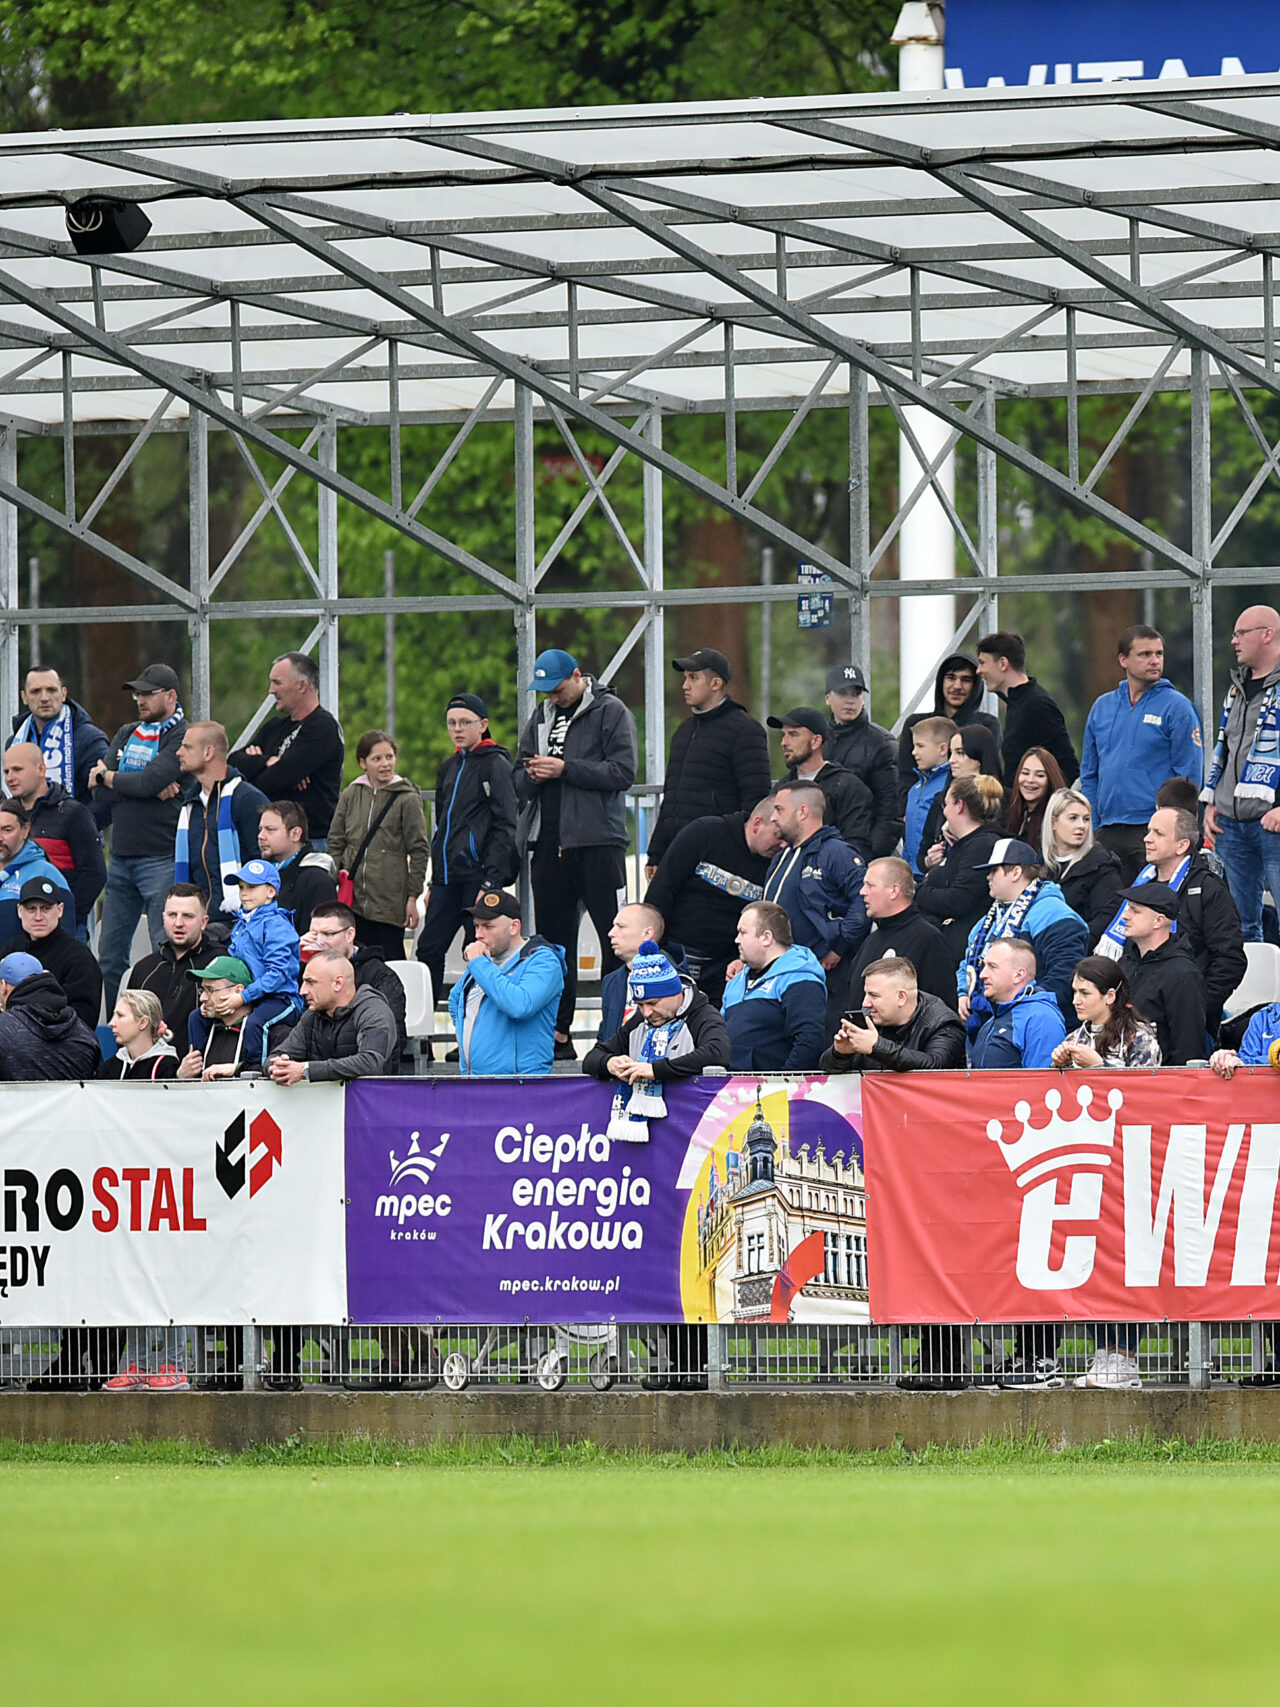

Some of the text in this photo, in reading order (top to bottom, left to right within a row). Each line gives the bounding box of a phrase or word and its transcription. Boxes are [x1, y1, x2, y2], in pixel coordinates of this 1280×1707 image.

[494, 1122, 611, 1174] Ciepła
[374, 1193, 452, 1225] mpec
[511, 1165, 651, 1218] energia
[390, 1228, 437, 1241] kraków
[482, 1210, 644, 1251] Krakowa
[499, 1275, 621, 1295] mpec.krakow.pl
